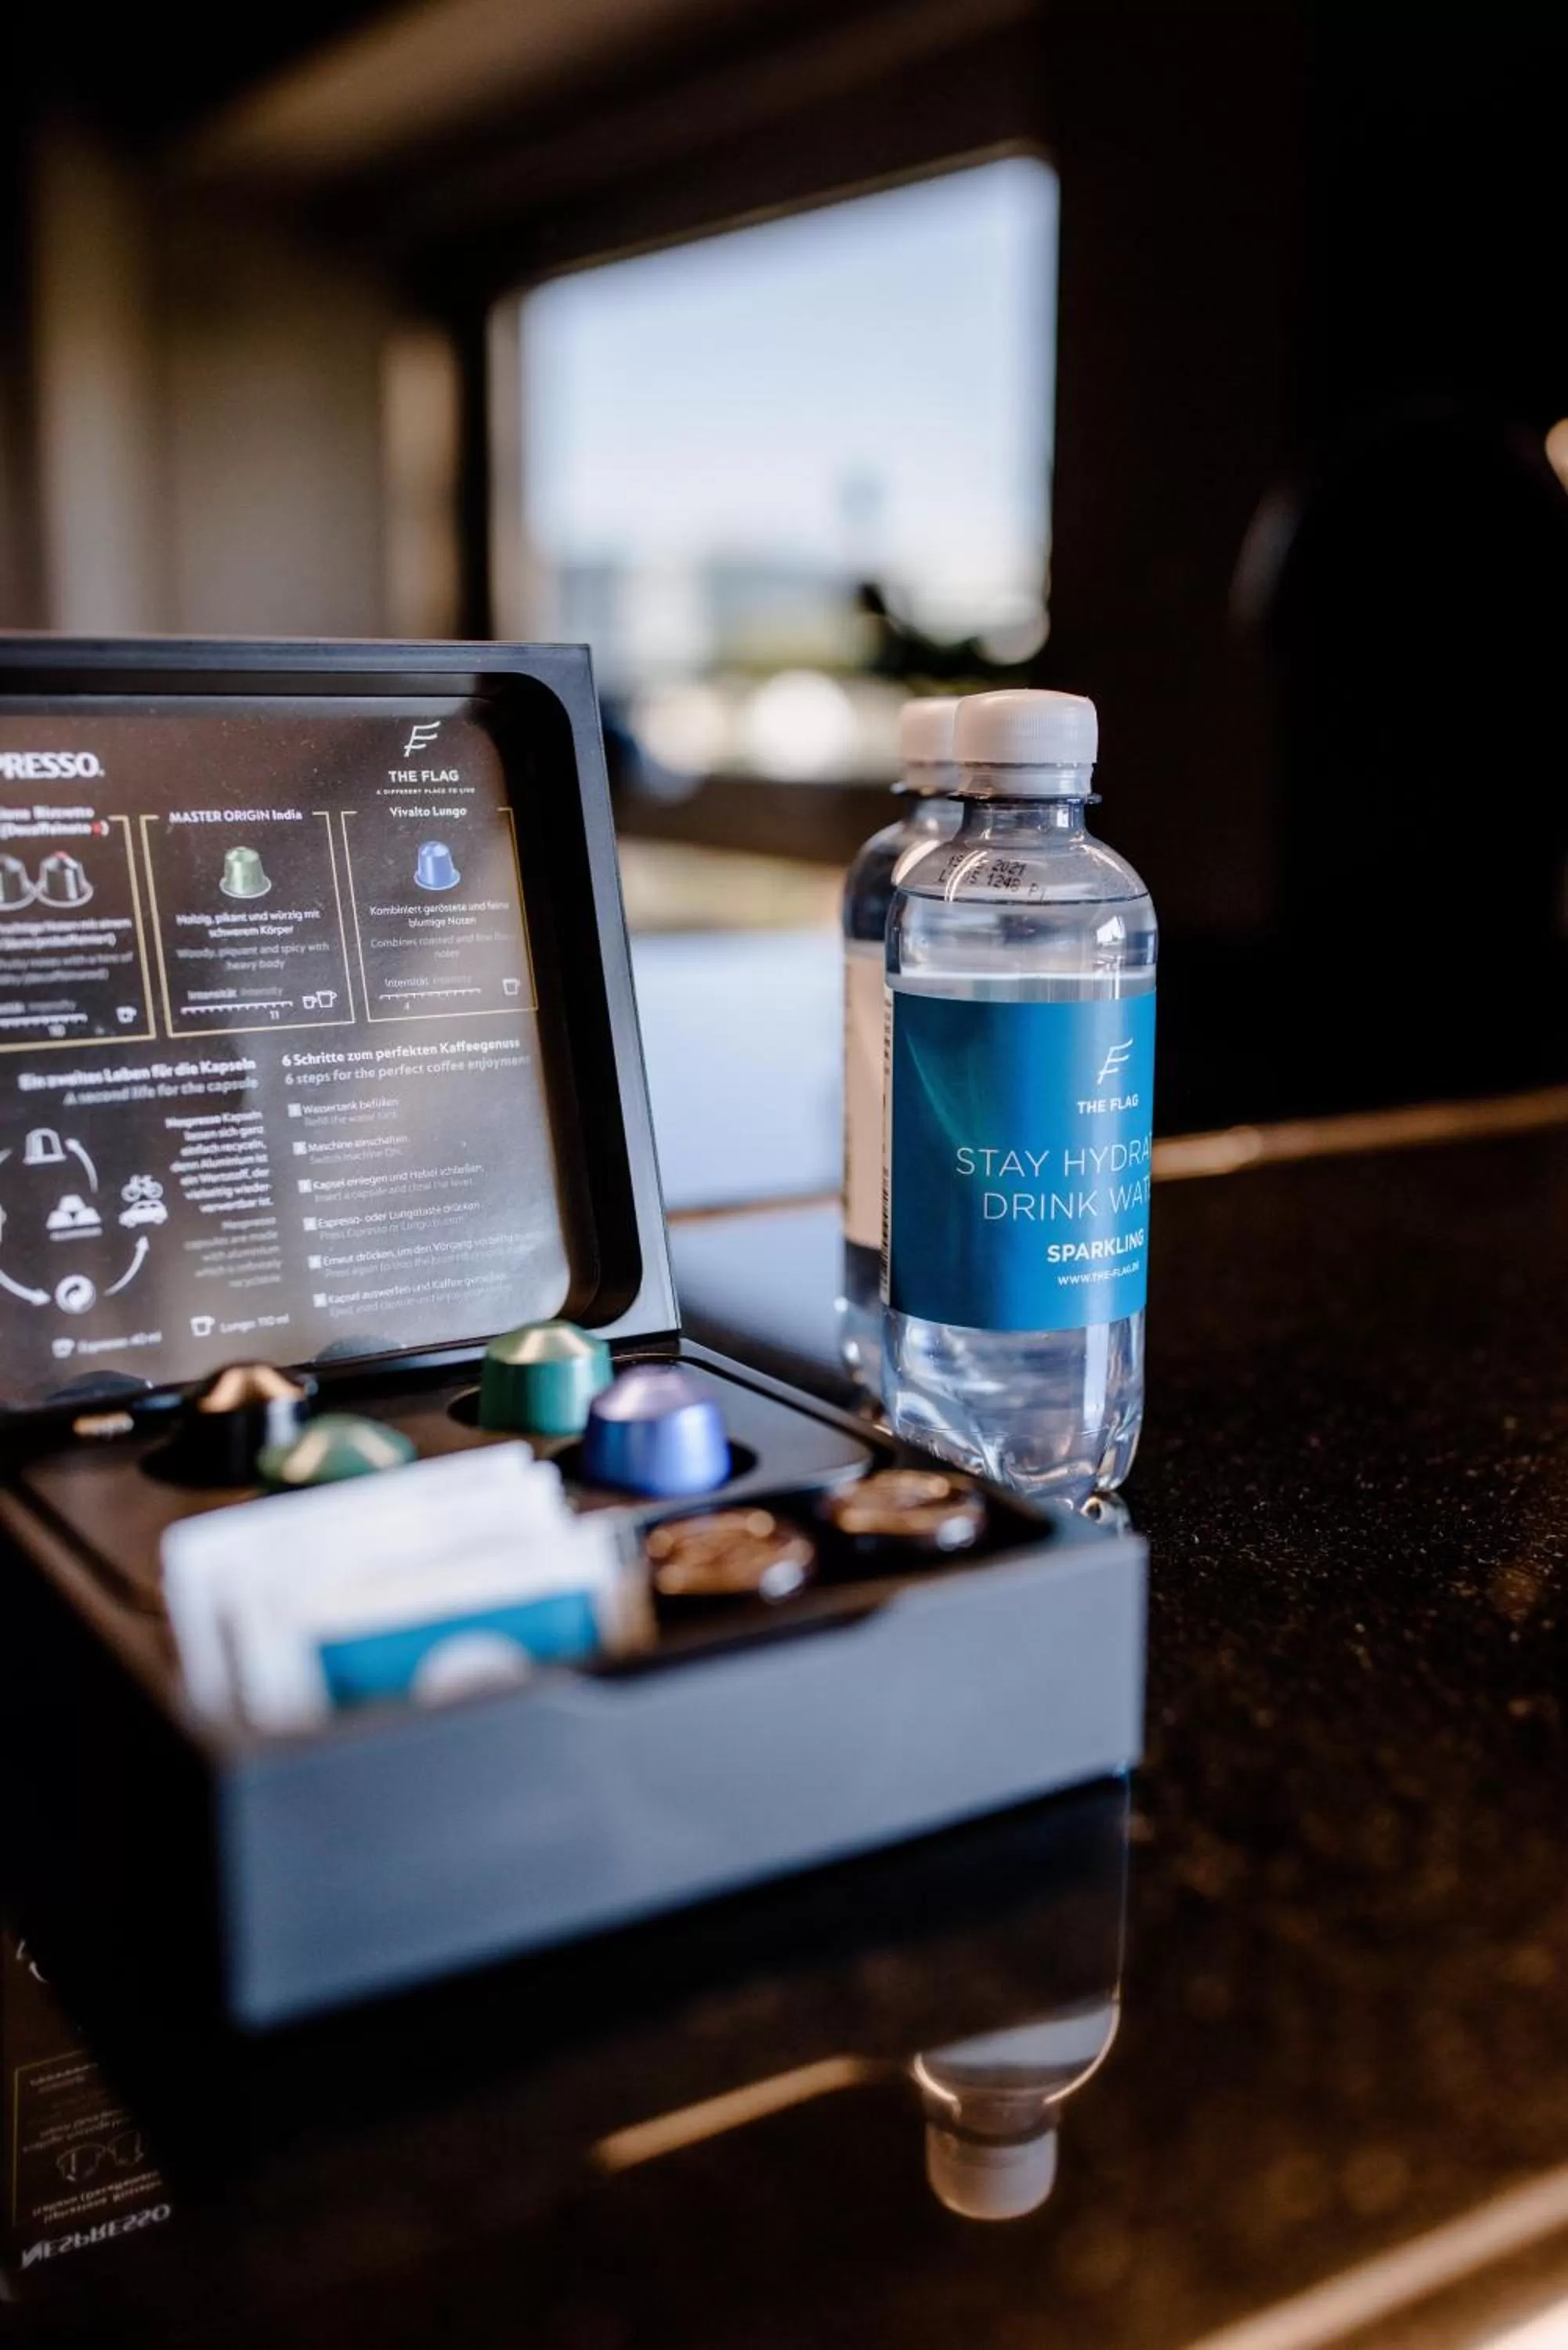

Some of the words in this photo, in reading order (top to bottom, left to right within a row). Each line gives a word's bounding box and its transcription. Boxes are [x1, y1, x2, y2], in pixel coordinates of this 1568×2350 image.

[388, 770, 417, 783] THE
[421, 769, 460, 783] FLAG
[168, 810, 222, 823] MASTER
[224, 809, 270, 822] ORIGIN
[272, 808, 303, 821] India
[388, 806, 430, 819] Vivalto
[432, 805, 468, 819] Lungo
[282, 1054, 292, 1067] 6
[293, 1053, 345, 1066] Schritte
[347, 1050, 374, 1062] zum
[375, 1044, 438, 1062] perfekten
[439, 1038, 521, 1054] Kaffeegenuss
[284, 1073, 294, 1086] 6
[296, 1071, 331, 1086] steps
[333, 1068, 352, 1083] for
[354, 1068, 376, 1079] the
[378, 1062, 425, 1081] perfect
[1077, 1099, 1106, 1115] THE
[1110, 1094, 1140, 1111] FLAG
[956, 1147, 1050, 1178] STAY
[983, 1190, 1098, 1222] DRINK
[1108, 1175, 1151, 1214] WAT
[1046, 1227, 1144, 1263] SPARKLING
